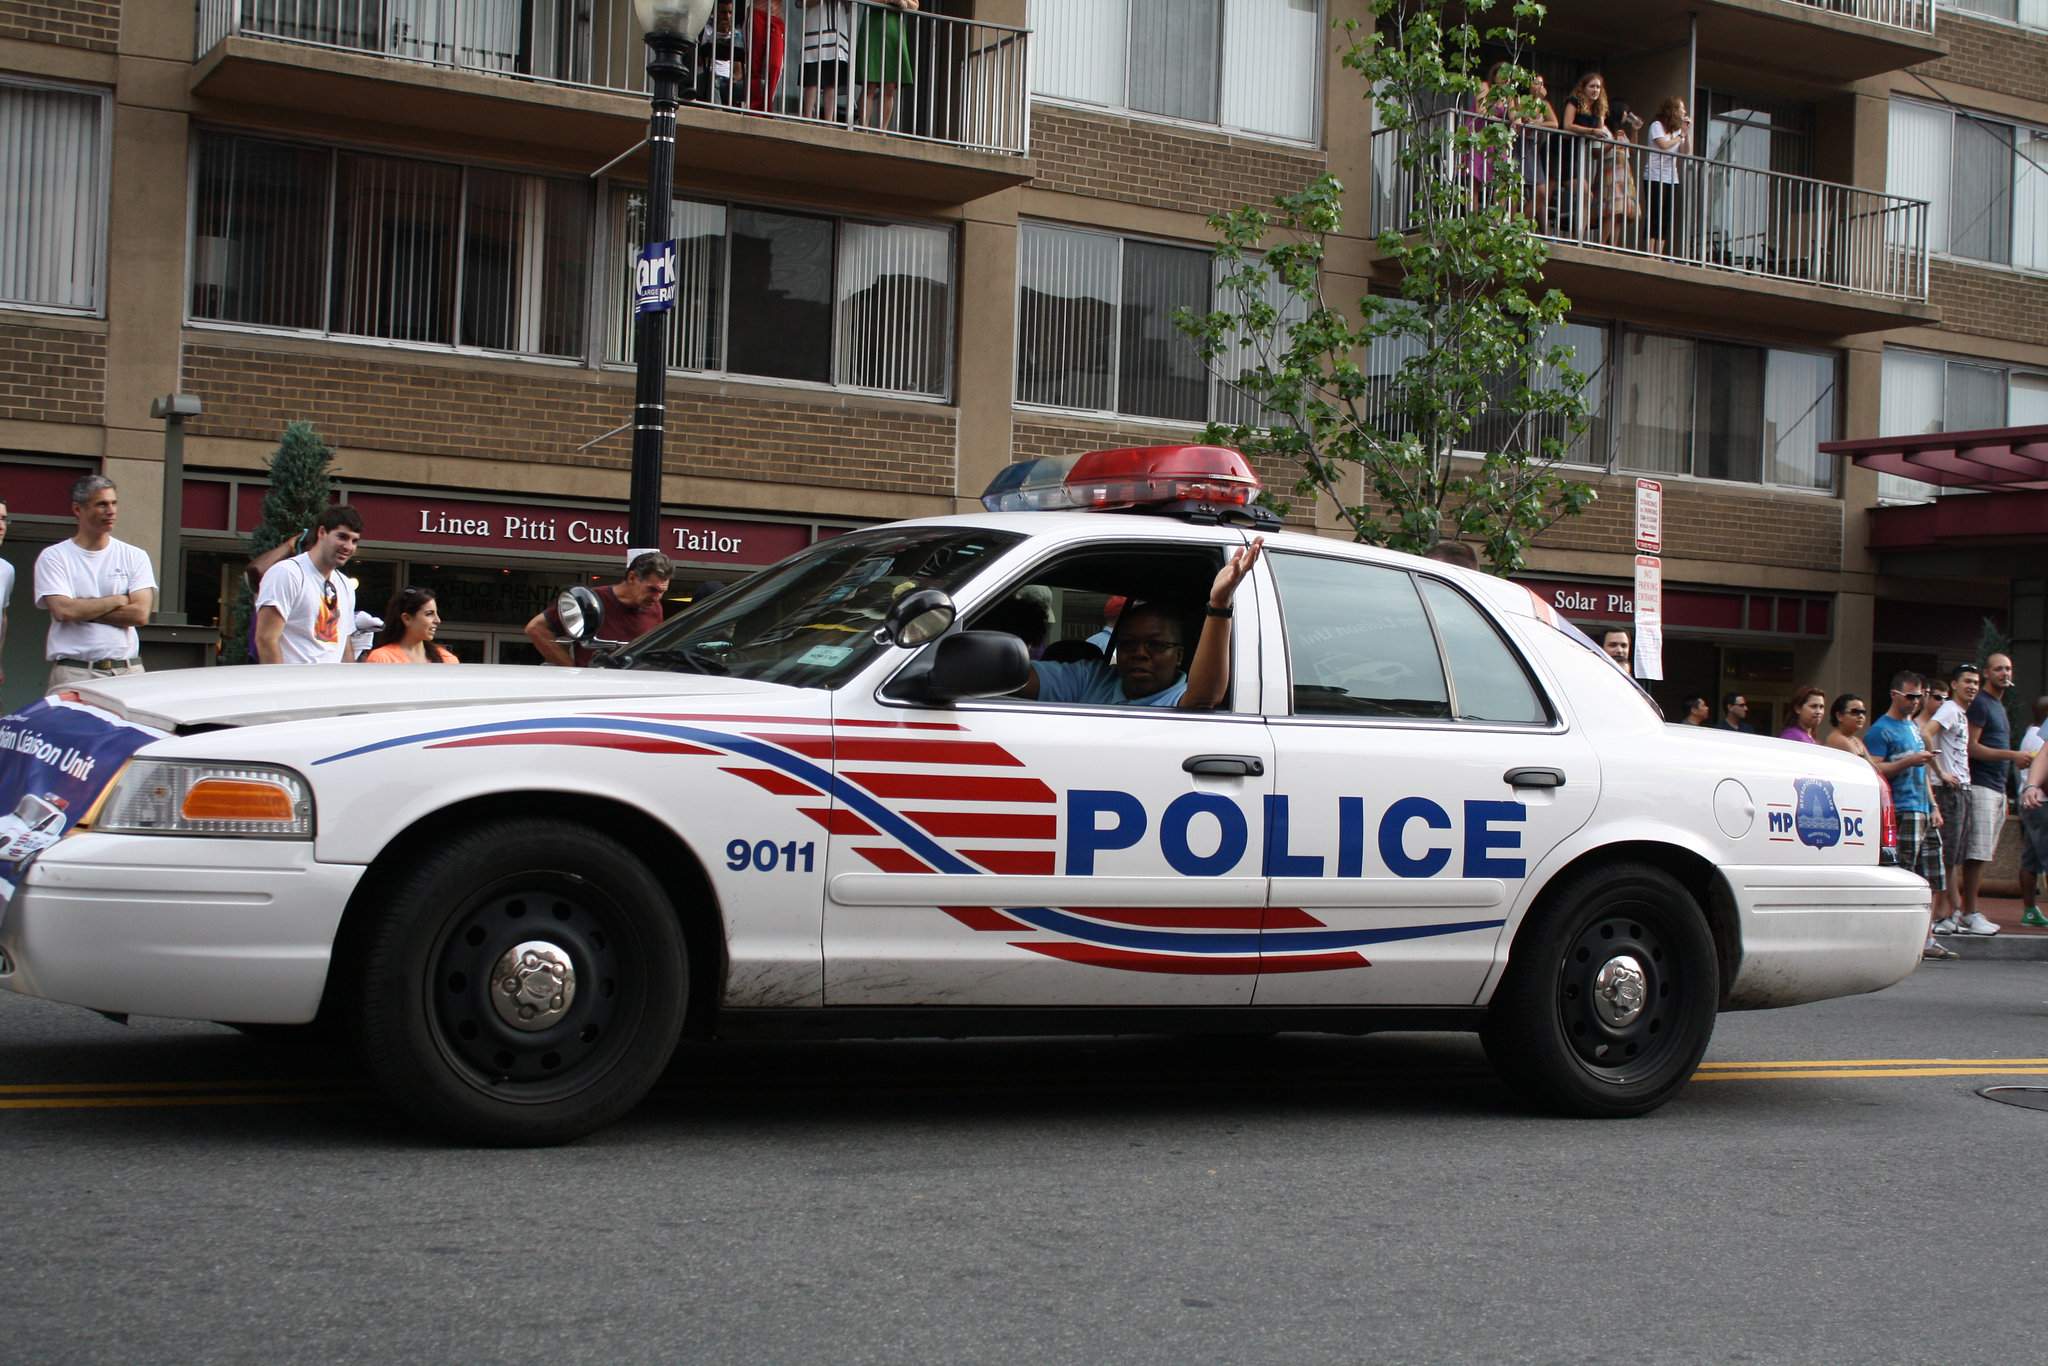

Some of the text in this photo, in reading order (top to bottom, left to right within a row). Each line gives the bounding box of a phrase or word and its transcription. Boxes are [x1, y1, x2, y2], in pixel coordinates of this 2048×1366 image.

[660, 285, 676, 302] RAY
[419, 510, 742, 553] Linea Pitti Custo Tailor
[1638, 580, 1658, 592] PARKING
[1555, 591, 1635, 614] Solar Pla
[16, 729, 62, 765] Liaison
[60, 747, 96, 781] Unit
[1065, 789, 1527, 878] POLICE
[1768, 812, 1864, 837] MP DC
[725, 838, 814, 872] 9011
